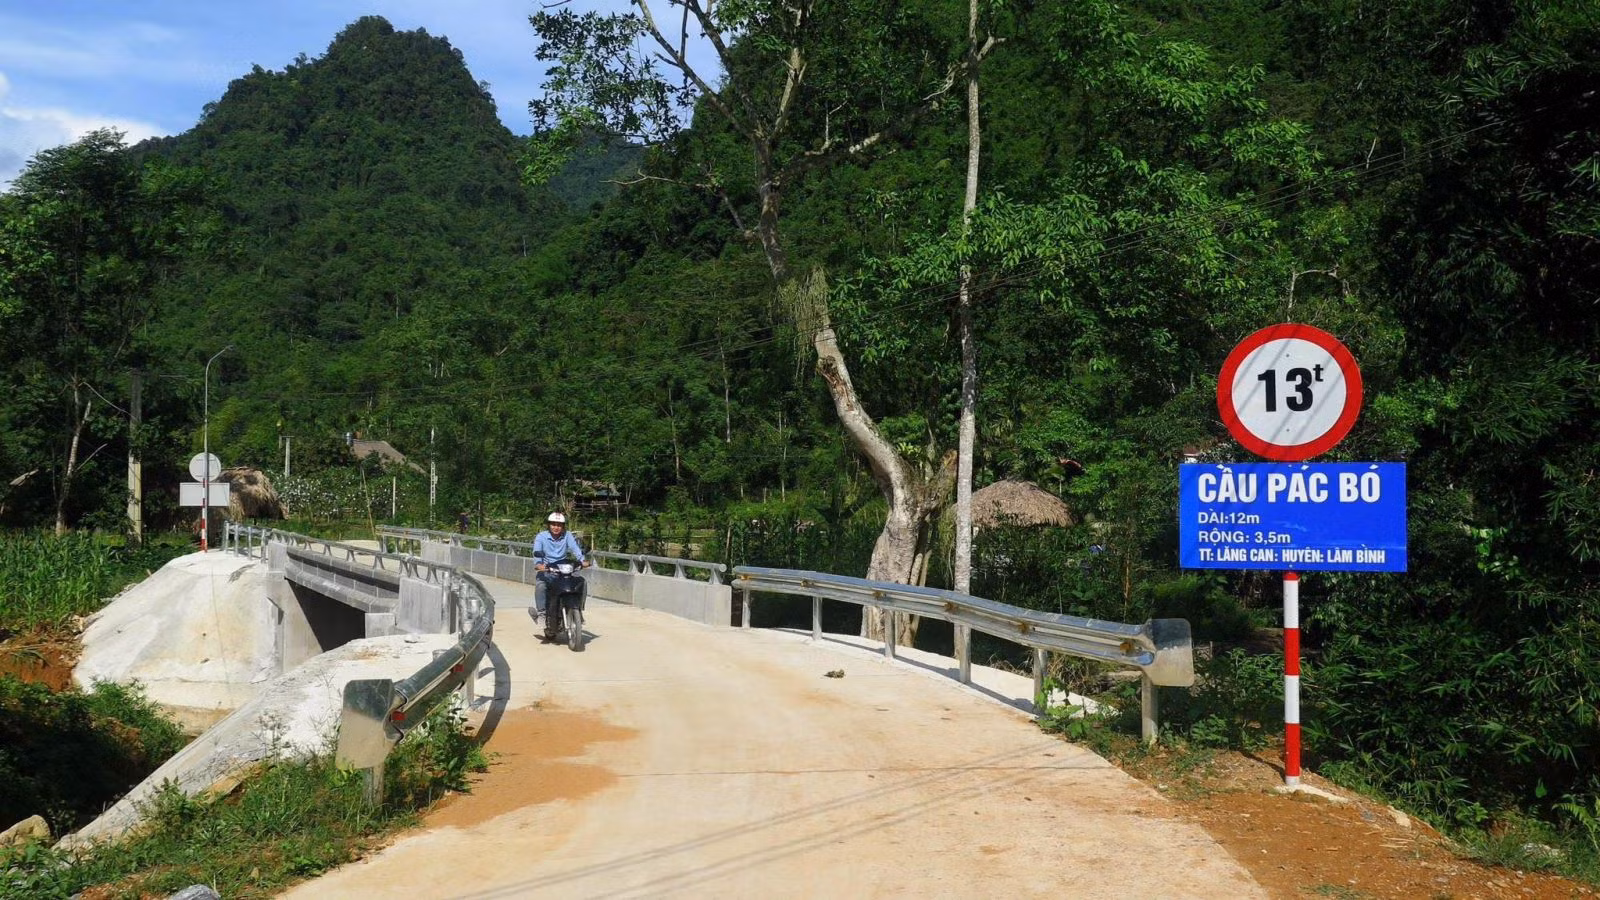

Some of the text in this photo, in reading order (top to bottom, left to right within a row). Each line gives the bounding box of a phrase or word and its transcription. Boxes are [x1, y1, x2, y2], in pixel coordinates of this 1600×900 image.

[1198, 464, 1380, 503] CẦU PÁC BÓ
[1198, 508, 1260, 524] DÀI:12m
[1198, 527, 1291, 546] RỘNG: 3,5m
[1199, 548, 1214, 561] TT:
[1217, 545, 1247, 562] LĂNG
[1327, 547, 1353, 563] LÂM
[1356, 543, 1386, 564] BÌNH
